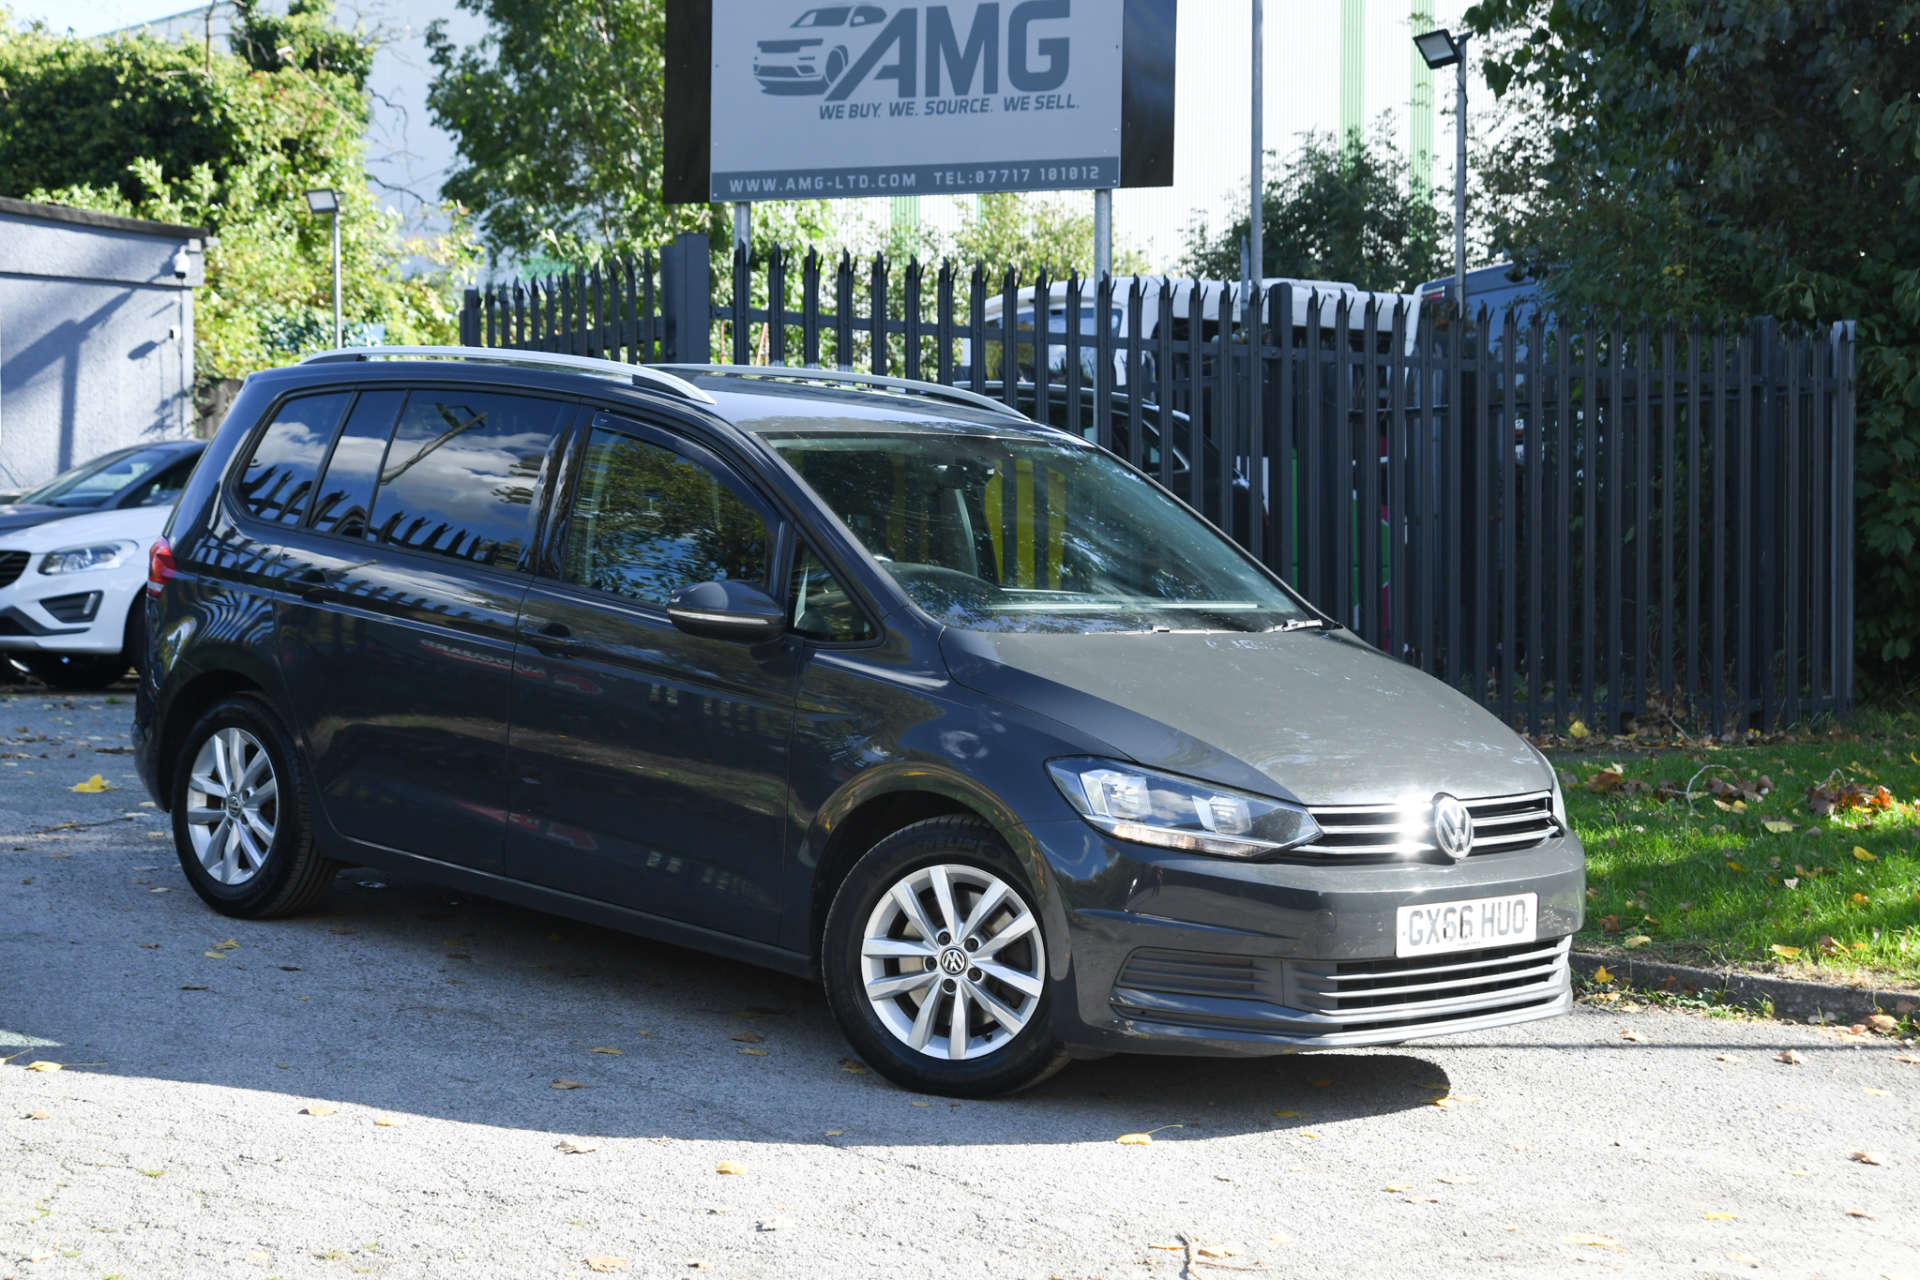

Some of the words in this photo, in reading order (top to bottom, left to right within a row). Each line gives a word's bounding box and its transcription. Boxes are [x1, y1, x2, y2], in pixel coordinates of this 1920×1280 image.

[824, 0, 1071, 102] AMG
[819, 104, 845, 120] WE
[848, 102, 882, 119] BUY.
[888, 101, 919, 117] WE.
[924, 97, 993, 116] SOURCE.
[1003, 95, 1030, 112] WE
[1034, 93, 1080, 111] SELL.
[729, 173, 917, 193] WWW.AMG-LTD.COM
[1408, 904, 1474, 946] GX66
